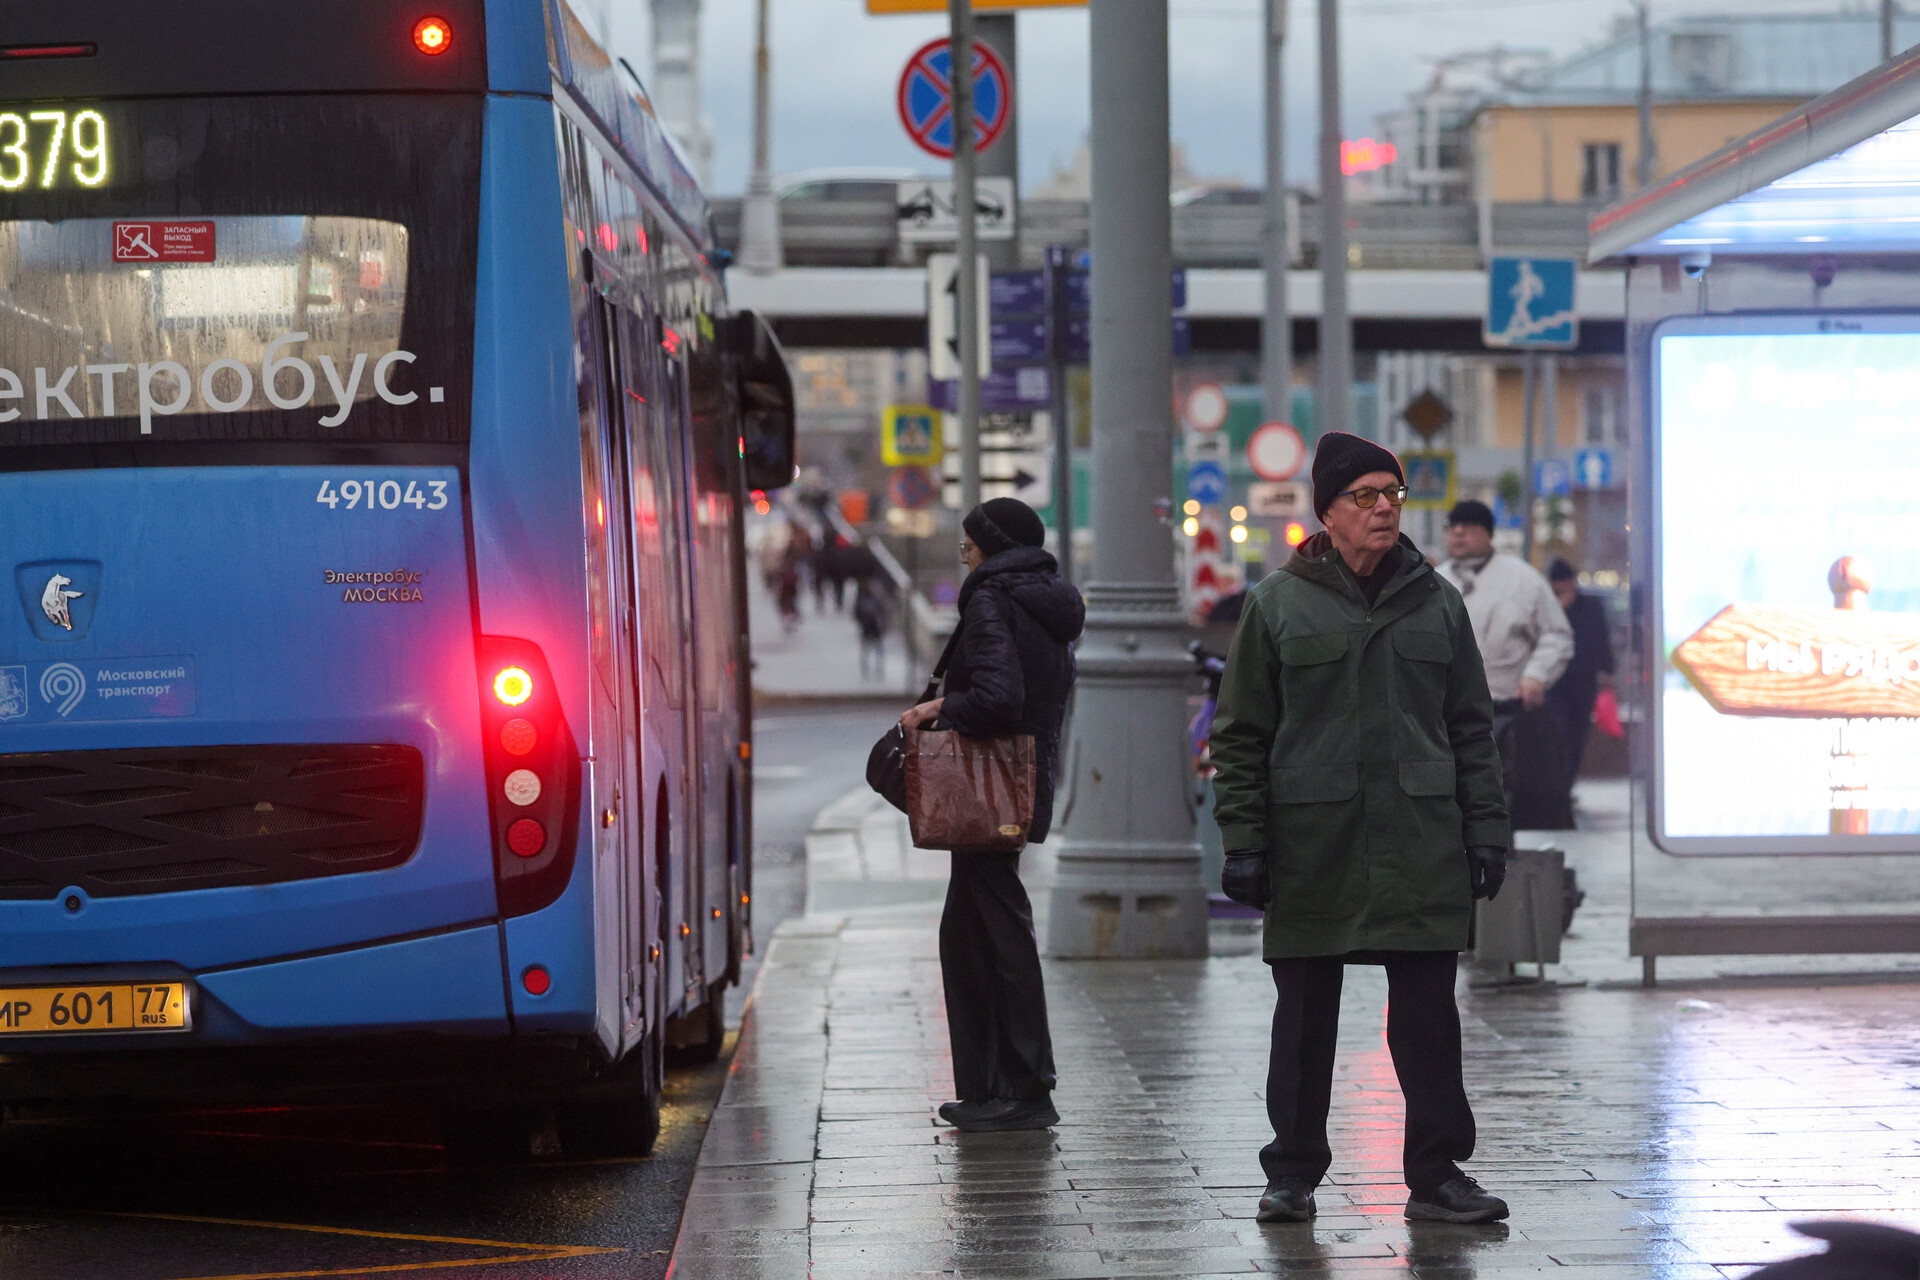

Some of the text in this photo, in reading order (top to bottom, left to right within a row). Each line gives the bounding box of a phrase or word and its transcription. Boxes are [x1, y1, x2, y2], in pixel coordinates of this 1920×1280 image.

[0, 111, 107, 188] 379
[316, 480, 448, 510] 491043
[324, 569, 422, 585] Электробус
[344, 588, 423, 602] МОСКВА
[1746, 638, 1814, 674] МЫ
[97, 667, 186, 682] Московский
[97, 685, 171, 699] транспорт
[50, 991, 113, 1025] 601
[137, 987, 170, 1013] 77
[142, 1014, 167, 1024] RUS
